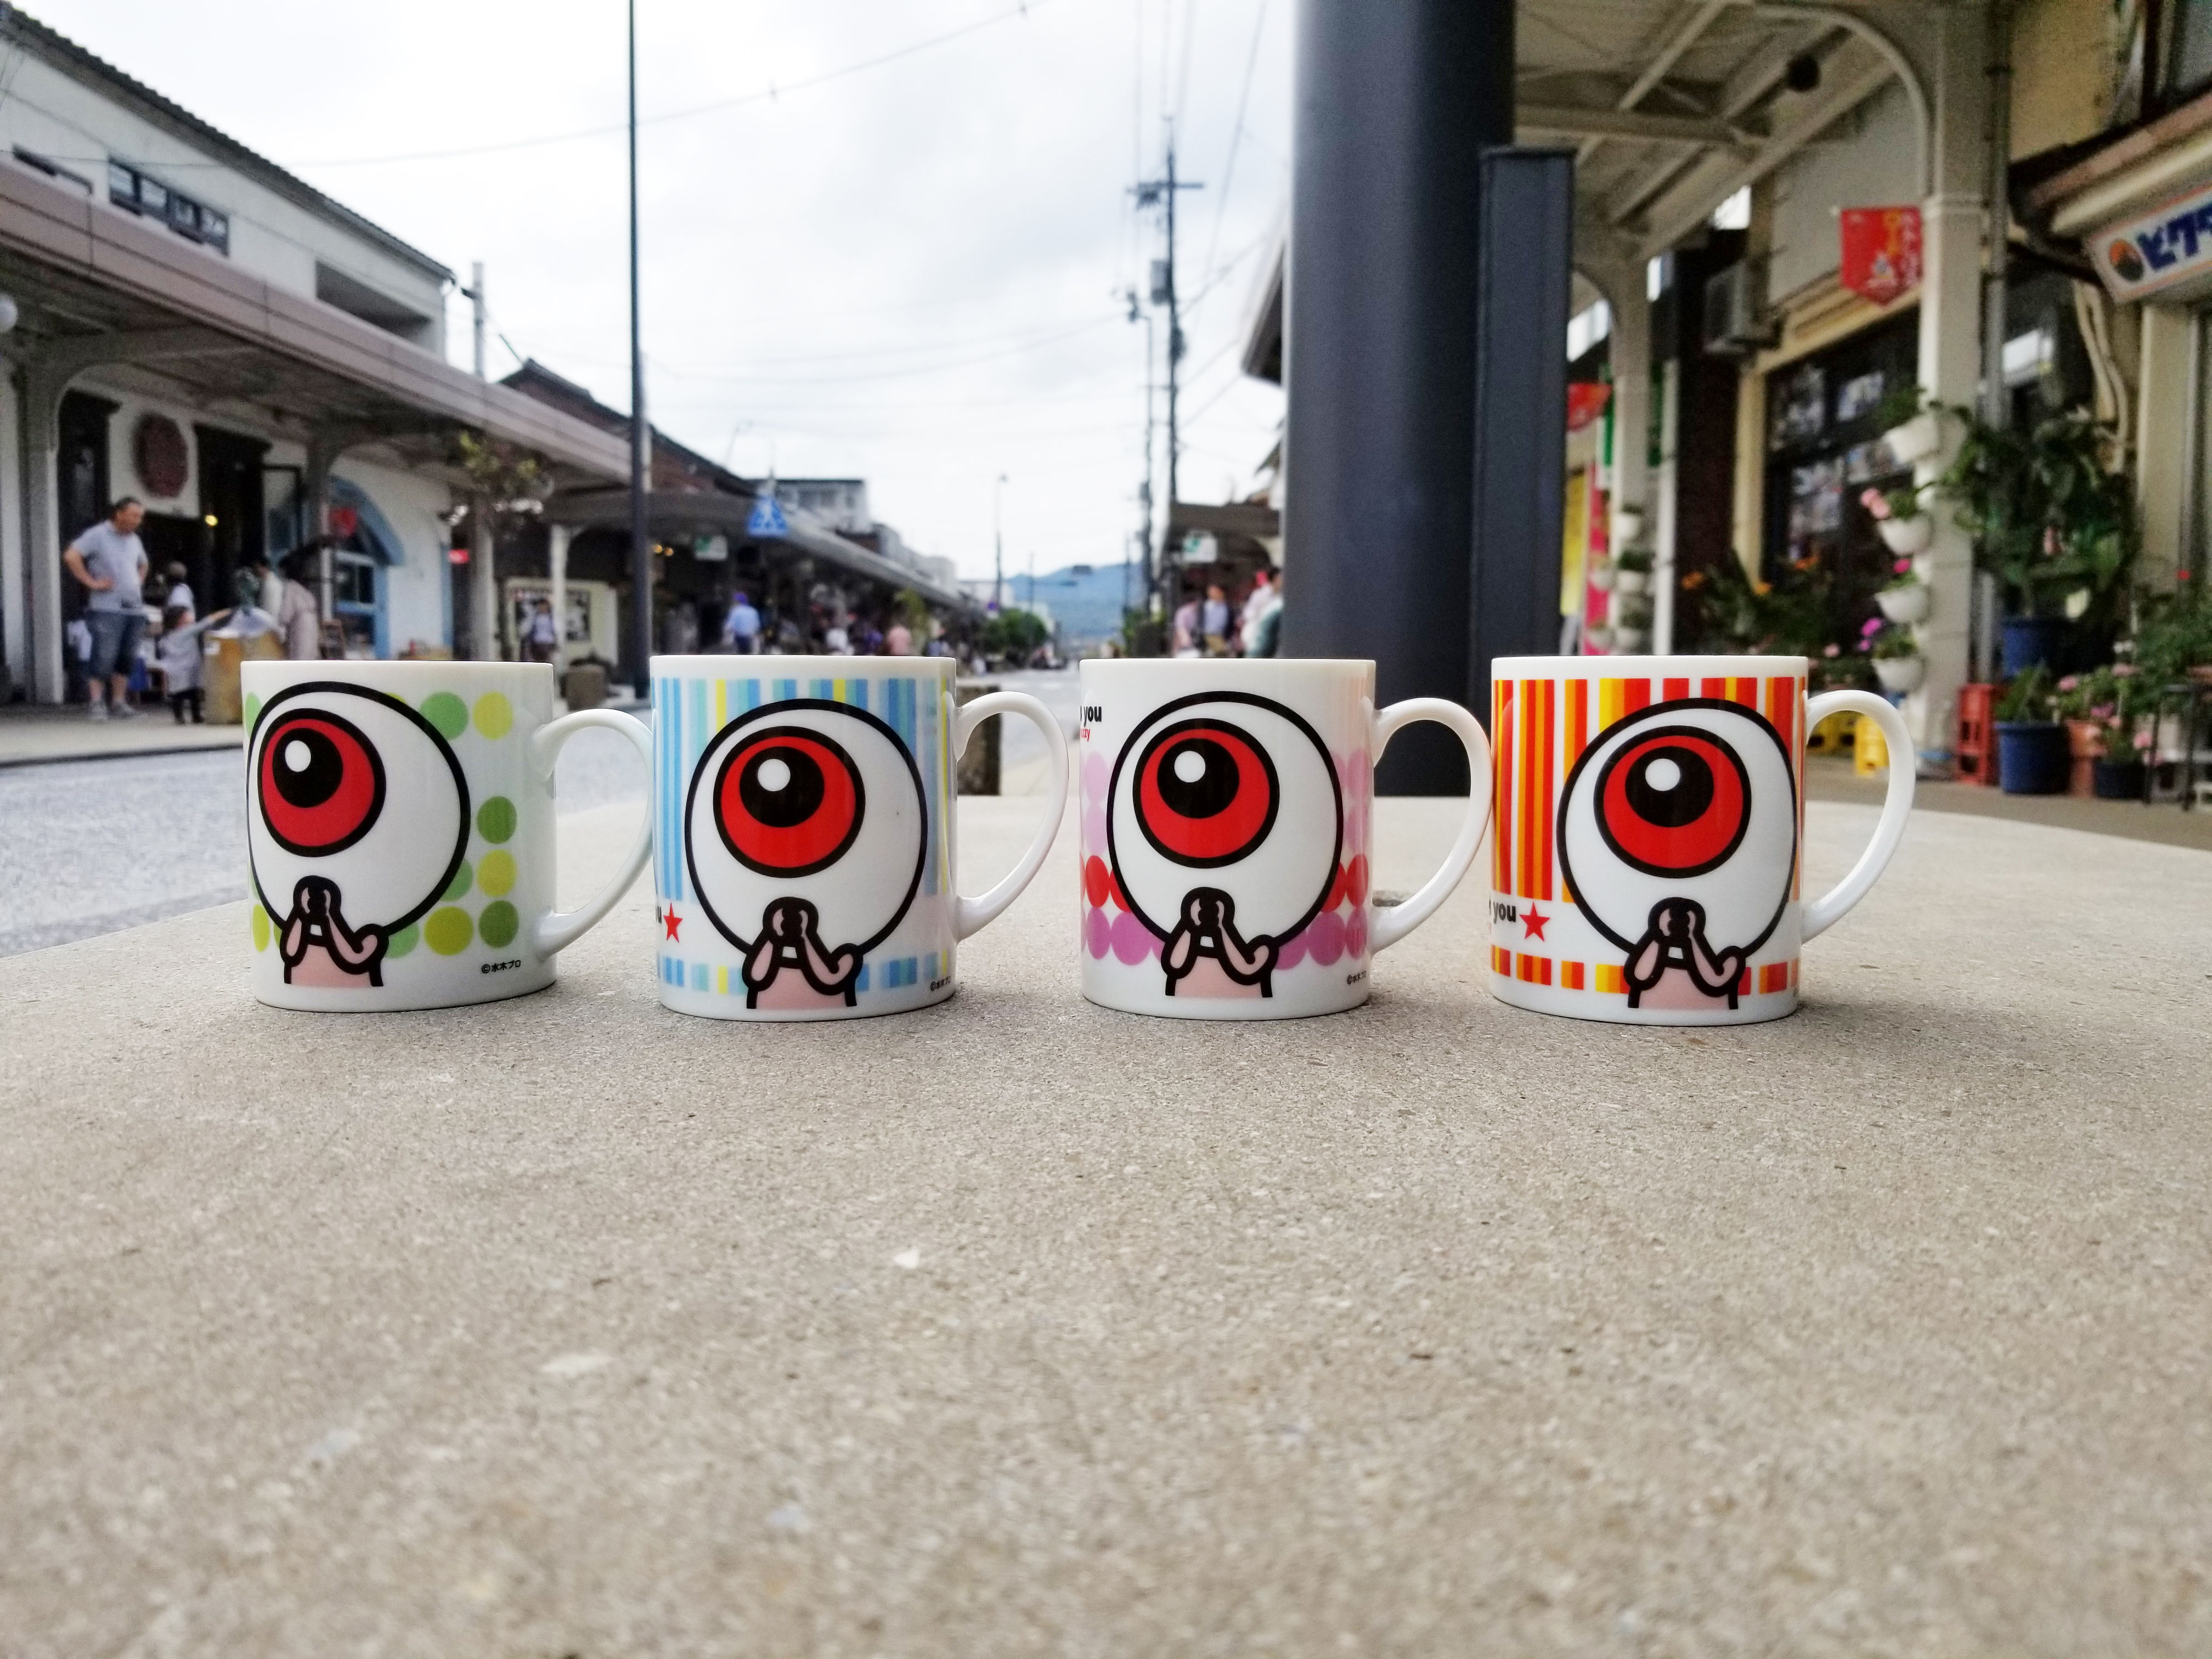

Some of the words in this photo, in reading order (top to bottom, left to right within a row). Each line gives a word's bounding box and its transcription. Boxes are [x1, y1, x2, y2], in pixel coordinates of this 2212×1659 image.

[1084, 706, 1102, 727] you
[1493, 901, 1516, 924] you
[481, 960, 521, 974] ©水木プロ
